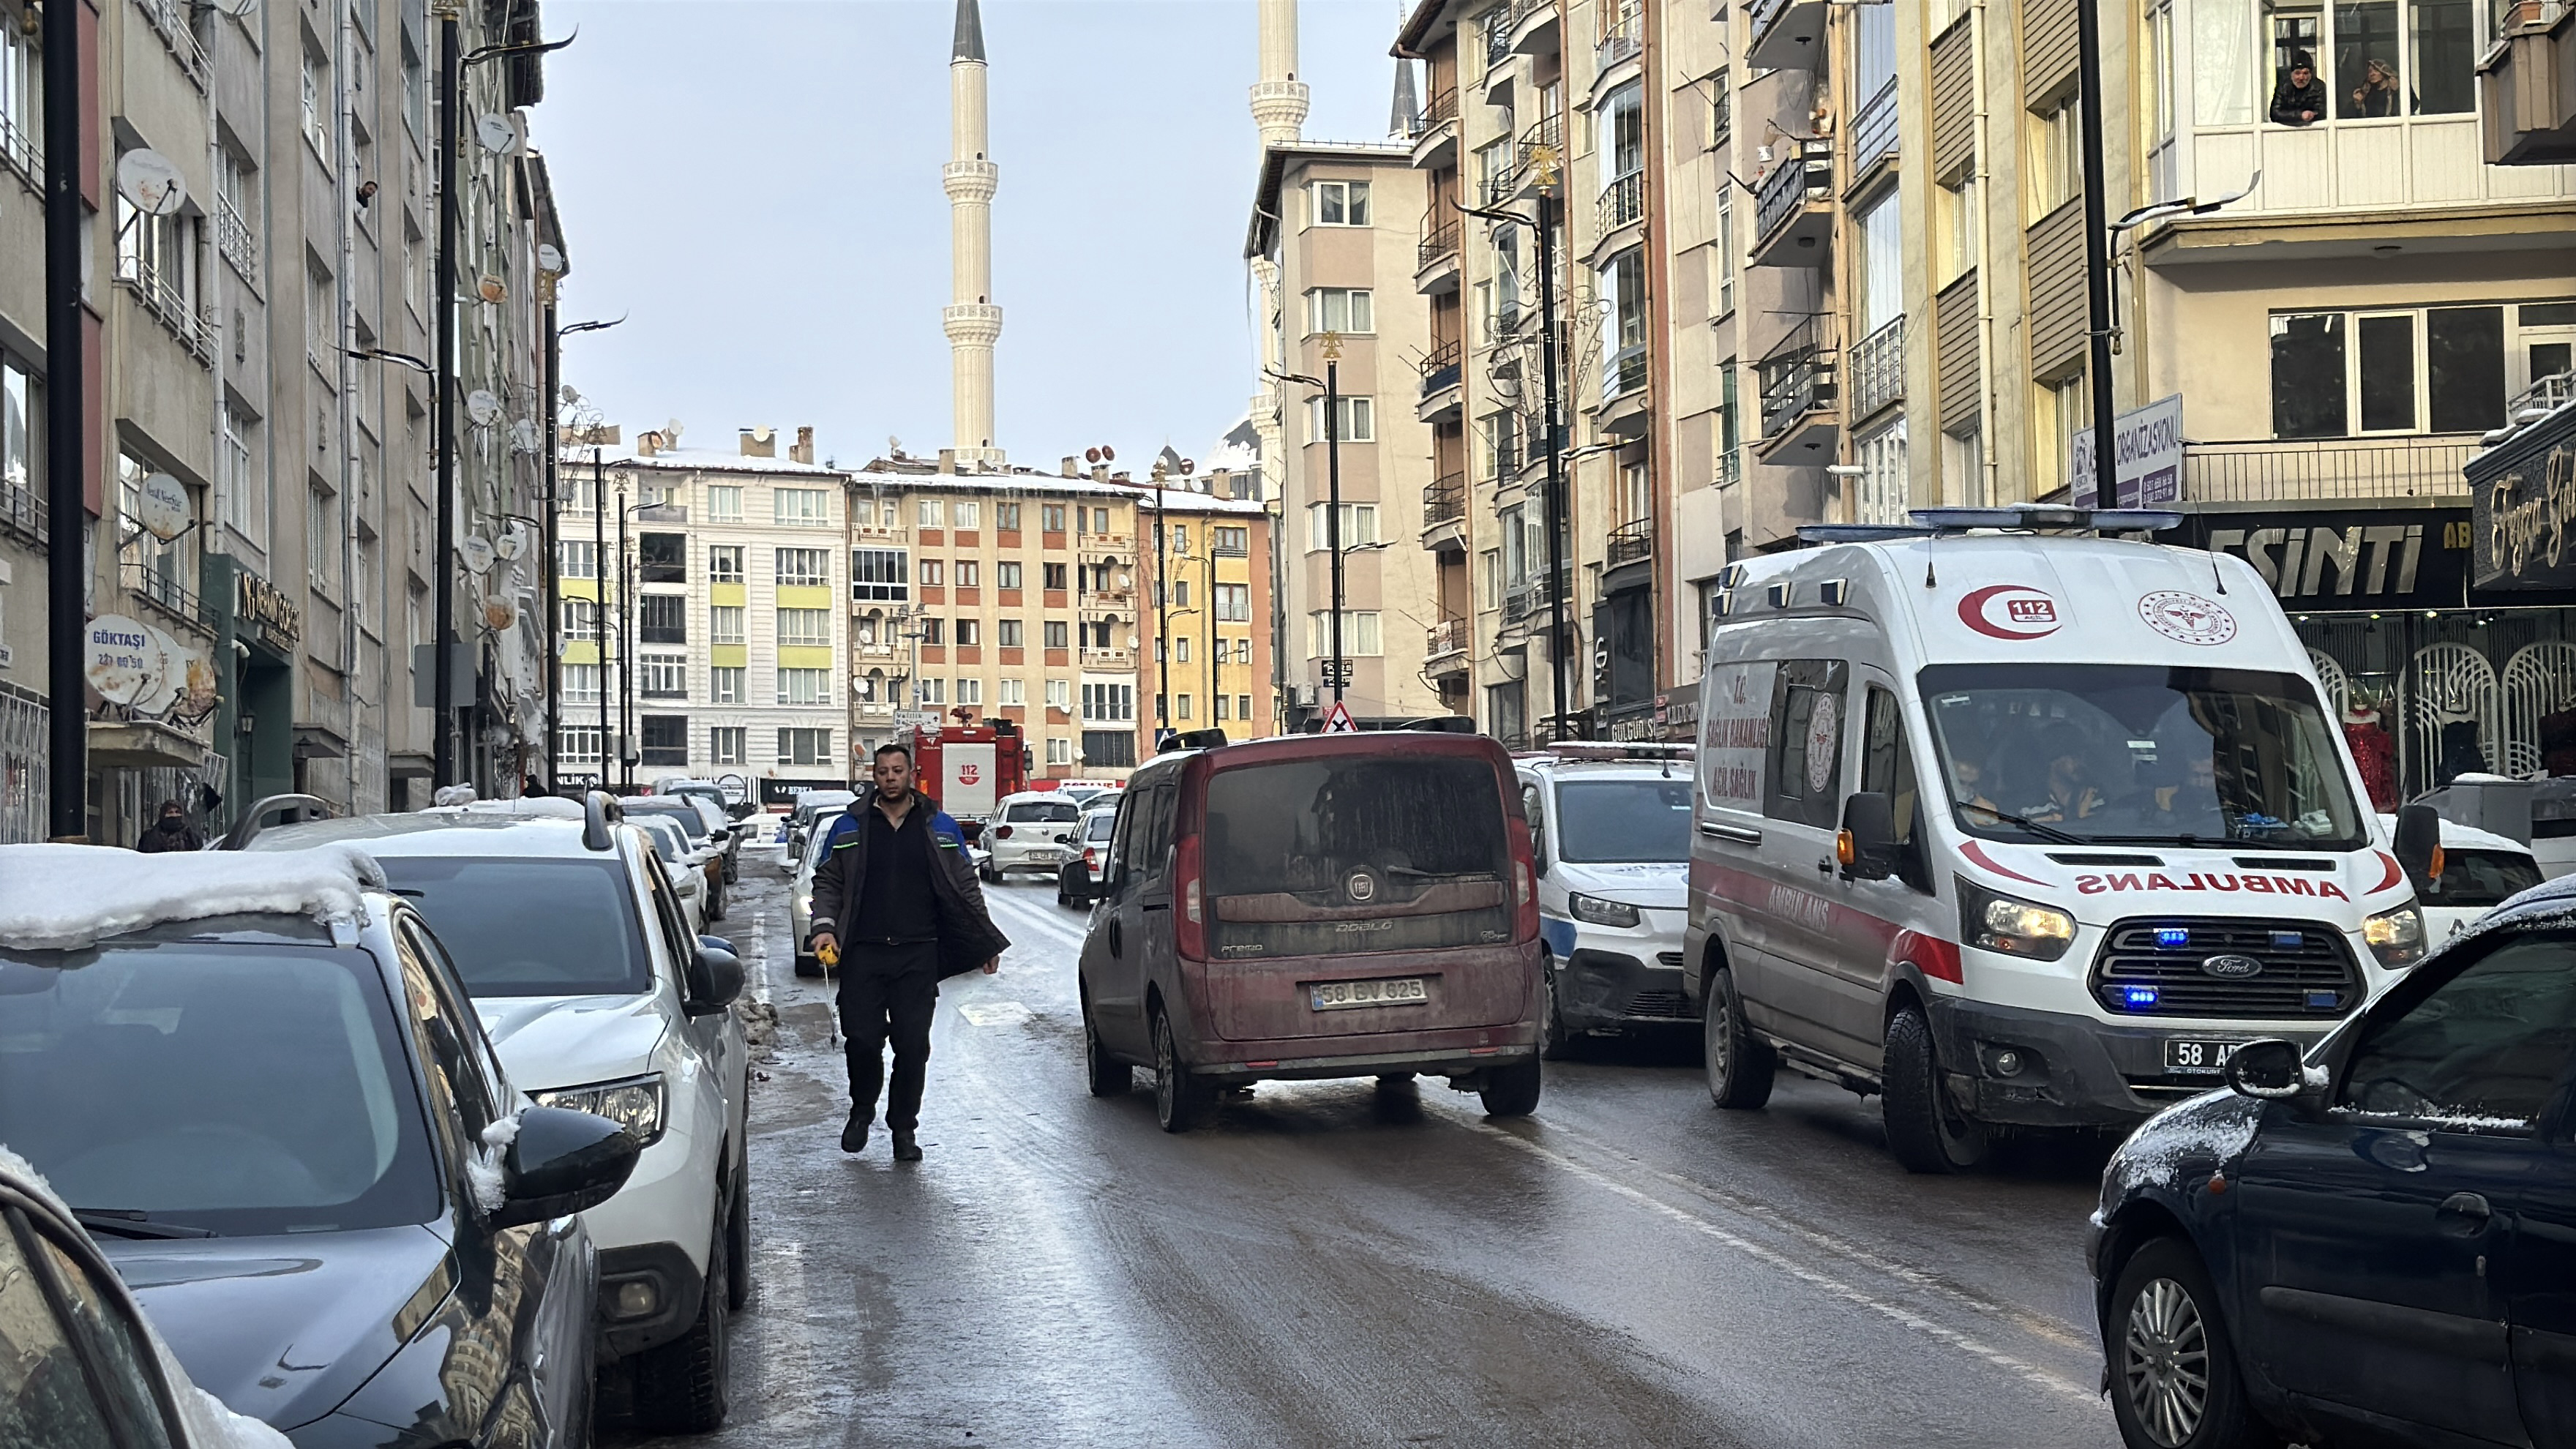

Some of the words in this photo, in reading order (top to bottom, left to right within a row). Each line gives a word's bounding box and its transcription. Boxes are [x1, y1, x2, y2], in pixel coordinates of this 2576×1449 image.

[2013, 602, 2049, 614] 112
[93, 629, 145, 650] GÖKTAŞI
[961, 765, 978, 775] 112
[1768, 885, 1830, 932] AMBULANS
[2217, 959, 2250, 973] Ford
[1322, 986, 1347, 1003] 58
[2178, 1043, 2203, 1066] 58
